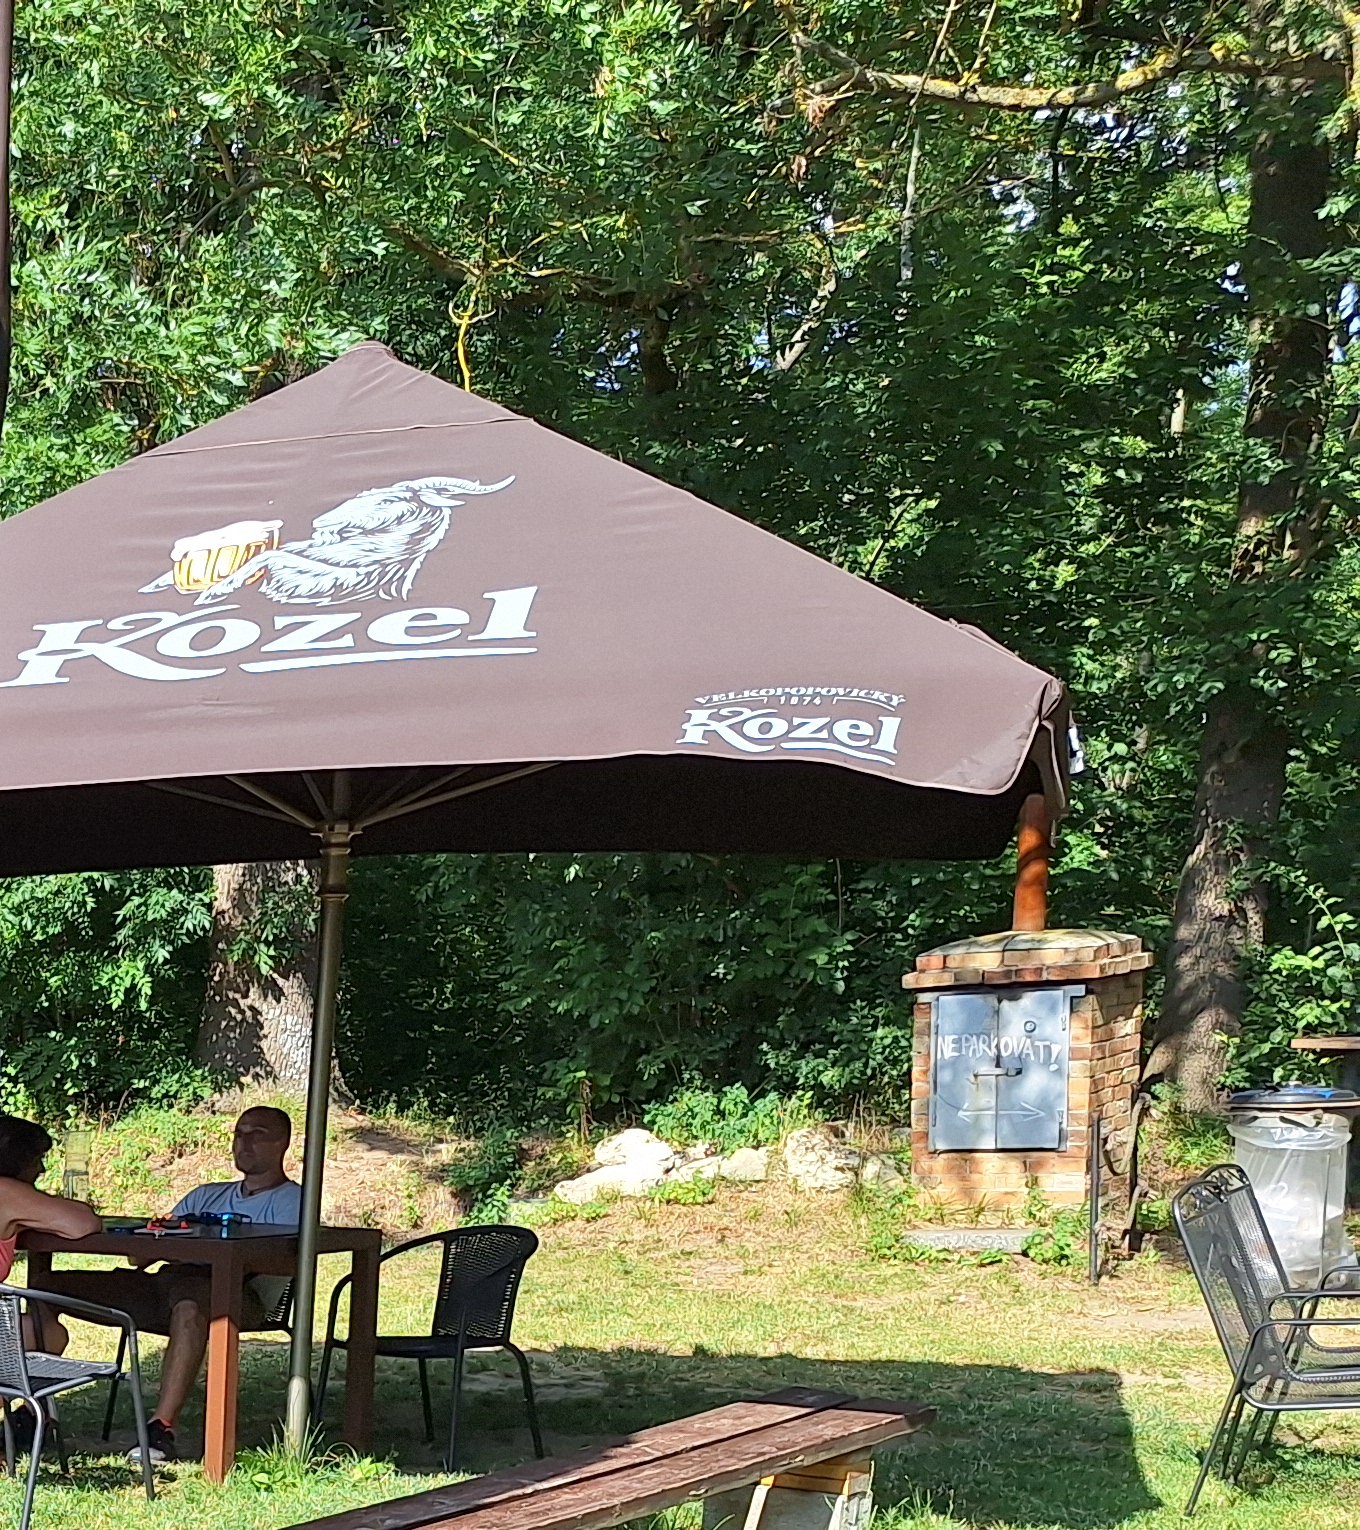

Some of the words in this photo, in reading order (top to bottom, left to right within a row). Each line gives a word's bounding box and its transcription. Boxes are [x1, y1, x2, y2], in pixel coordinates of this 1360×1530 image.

[780, 695, 821, 706] 1874
[675, 707, 902, 755] Kozel
[937, 1031, 1062, 1072] NEPARKOVAT!
